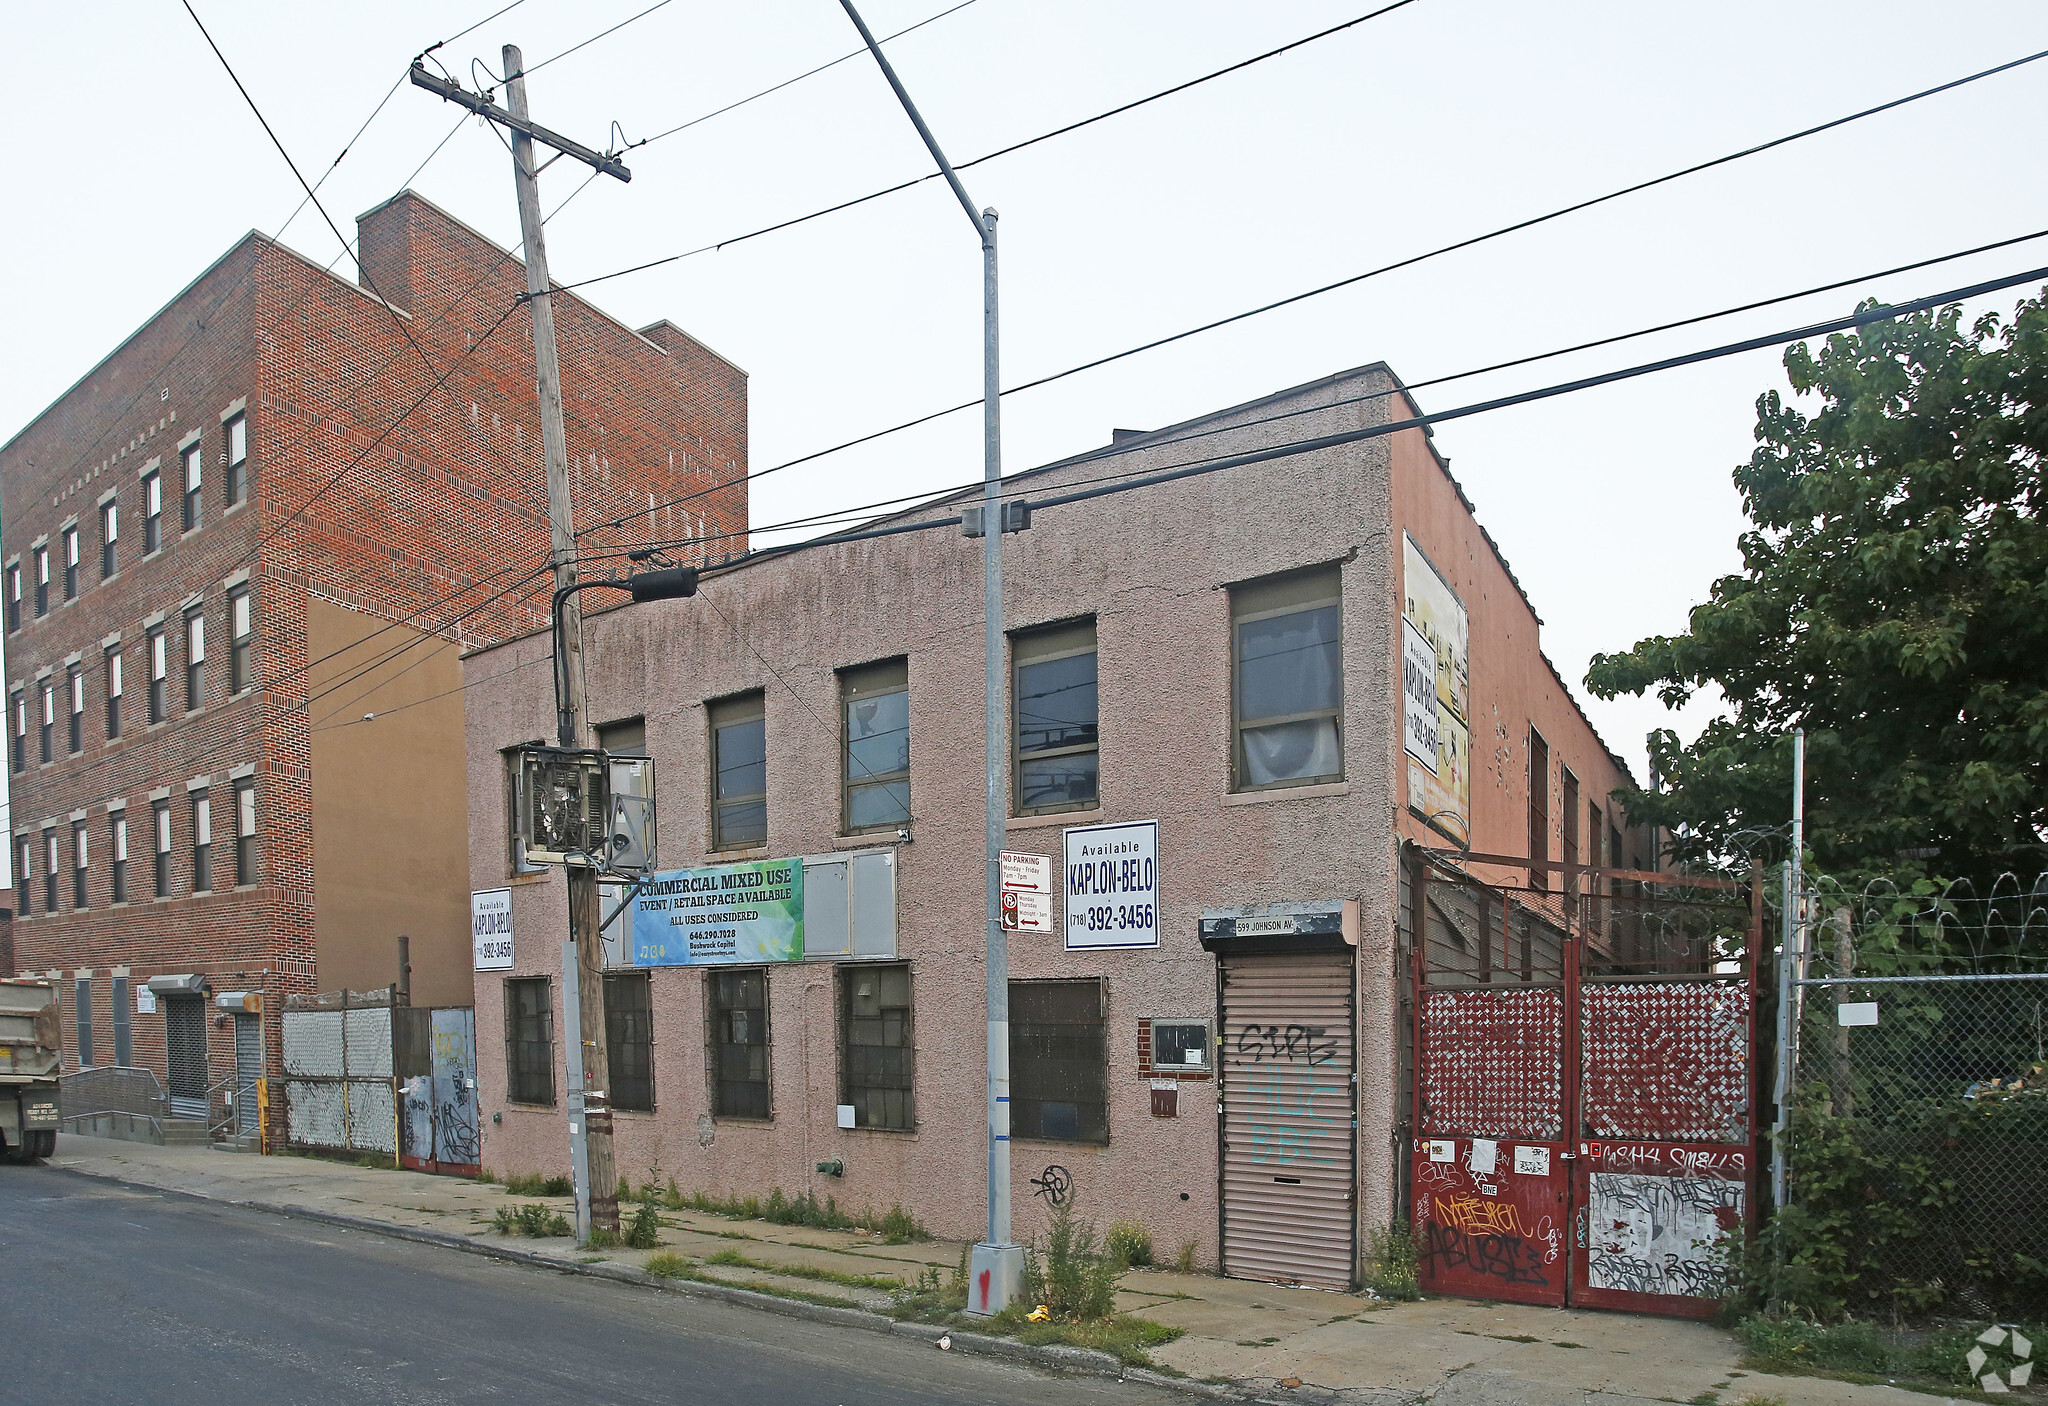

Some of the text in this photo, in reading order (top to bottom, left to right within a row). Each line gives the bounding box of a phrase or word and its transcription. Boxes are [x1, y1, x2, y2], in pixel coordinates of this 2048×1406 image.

[1082, 841, 1139, 857] Available
[1002, 854, 1040, 866] NO PARKING
[1003, 865, 1021, 873] Monday
[1025, 867, 1040, 875] Friday
[1070, 857, 1153, 896] KAPLON-BELO
[639, 868, 792, 897] COMMERCIAL MIXED USE
[480, 901, 504, 910] Available
[640, 888, 792, 912] EVENT / RETAIL SPACE AVAILABLE
[475, 911, 512, 936] KAPLON-BELO
[670, 910, 759, 926] ALL USES CONSIDERED
[1070, 903, 1153, 931] (718) 392-3456
[1251, 920, 1282, 932] JOHNSON
[689, 929, 736, 940] 646.290.7028
[483, 941, 512, 959] 392-3456
[716, 939, 736, 949] Capital
[1483, 1185, 1497, 1195] BNE
